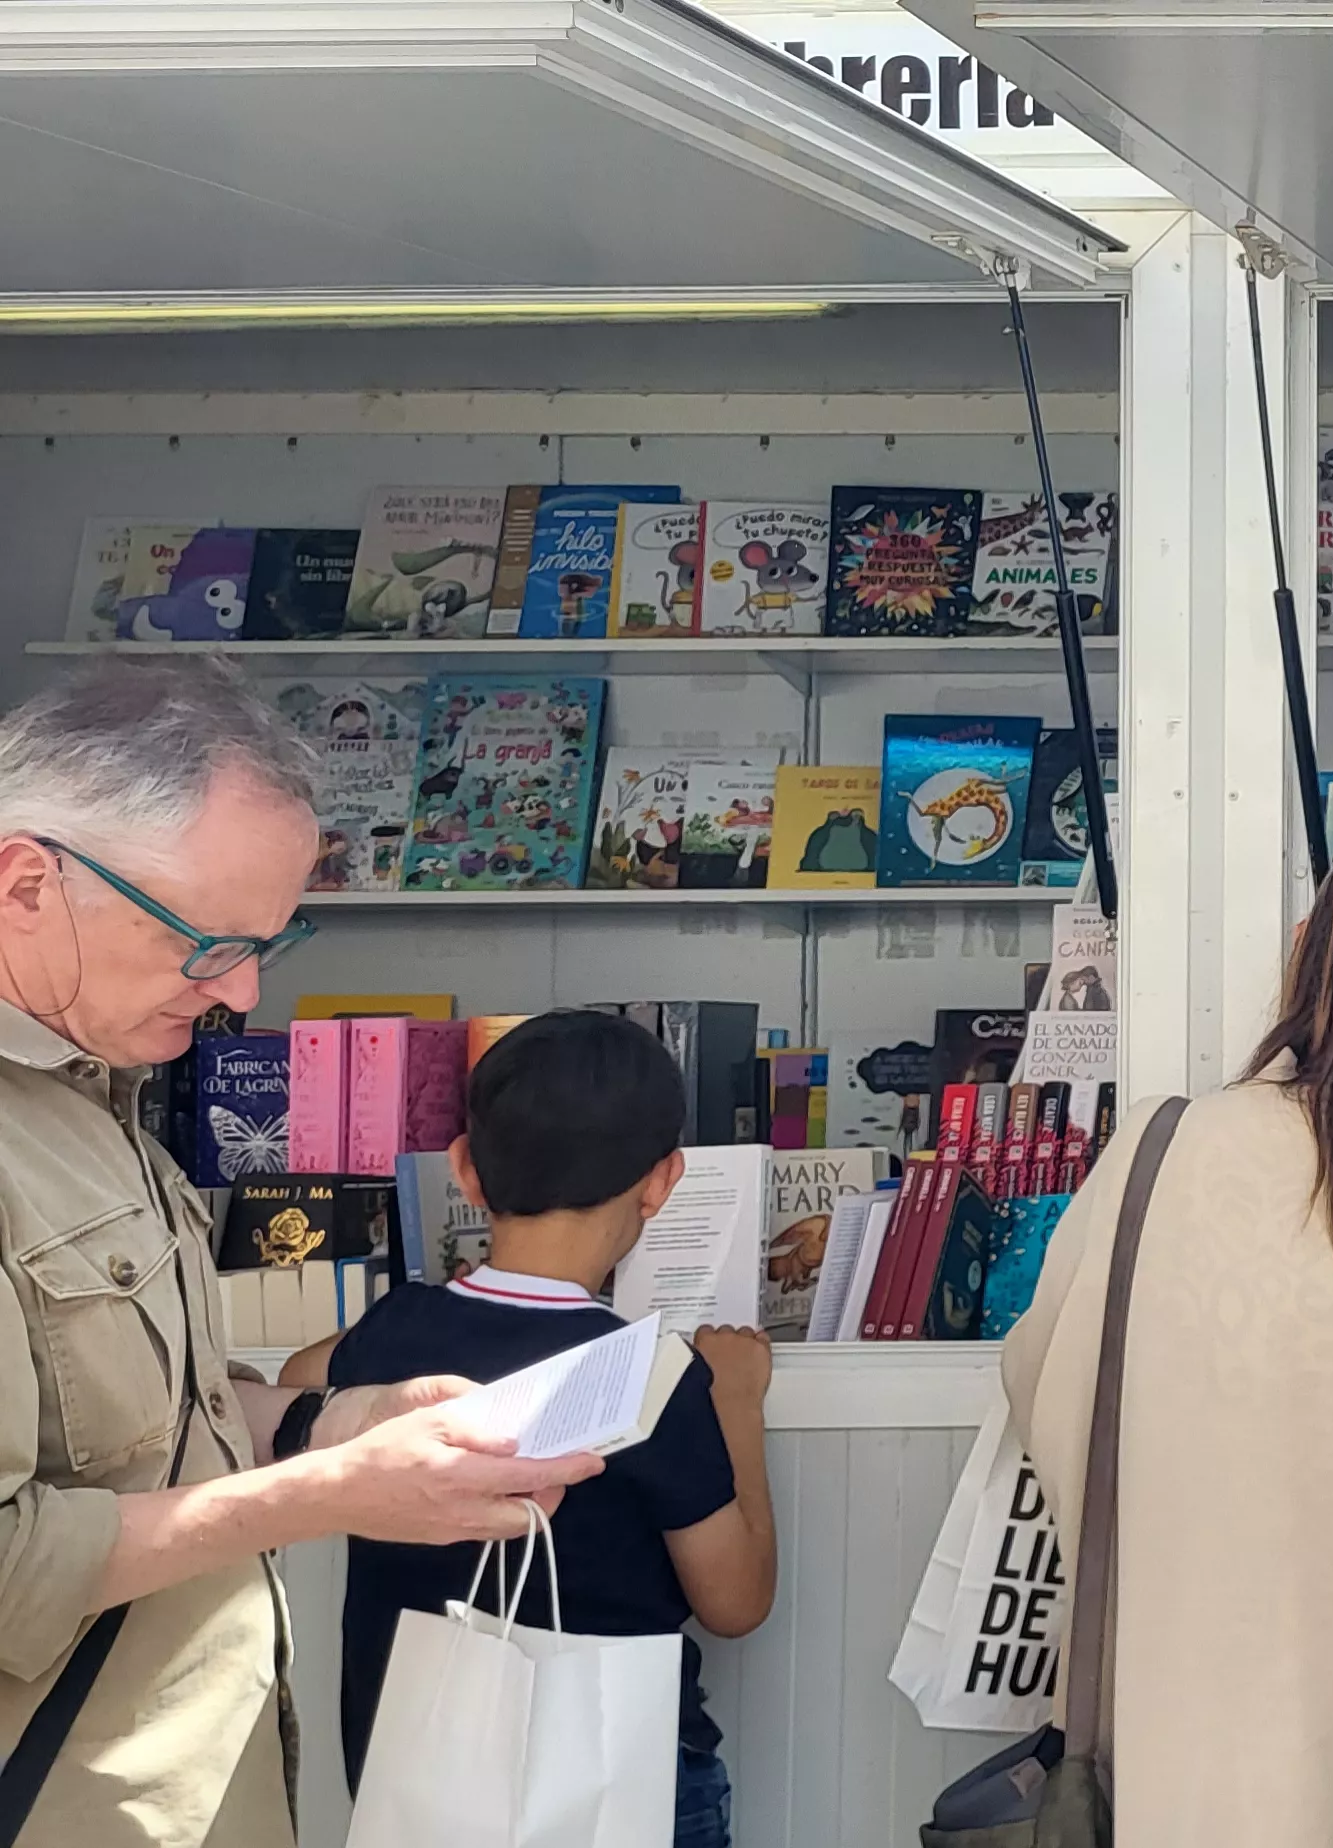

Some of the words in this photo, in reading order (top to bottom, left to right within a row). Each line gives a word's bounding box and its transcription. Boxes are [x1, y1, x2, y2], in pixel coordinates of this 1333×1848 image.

[769, 41, 1054, 129] rera
[556, 521, 605, 551] hilo
[985, 567, 1098, 584] ANIMAES
[1034, 1023, 1047, 1037] EL
[1032, 1037, 1049, 1051] DE
[1031, 1051, 1108, 1064] GONZALO
[1029, 1064, 1080, 1078] GINER
[772, 1160, 845, 1185] MARY
[242, 1186, 290, 1200] SARAH
[1009, 1467, 1055, 1525] D
[979, 1583, 1056, 1640] DE
